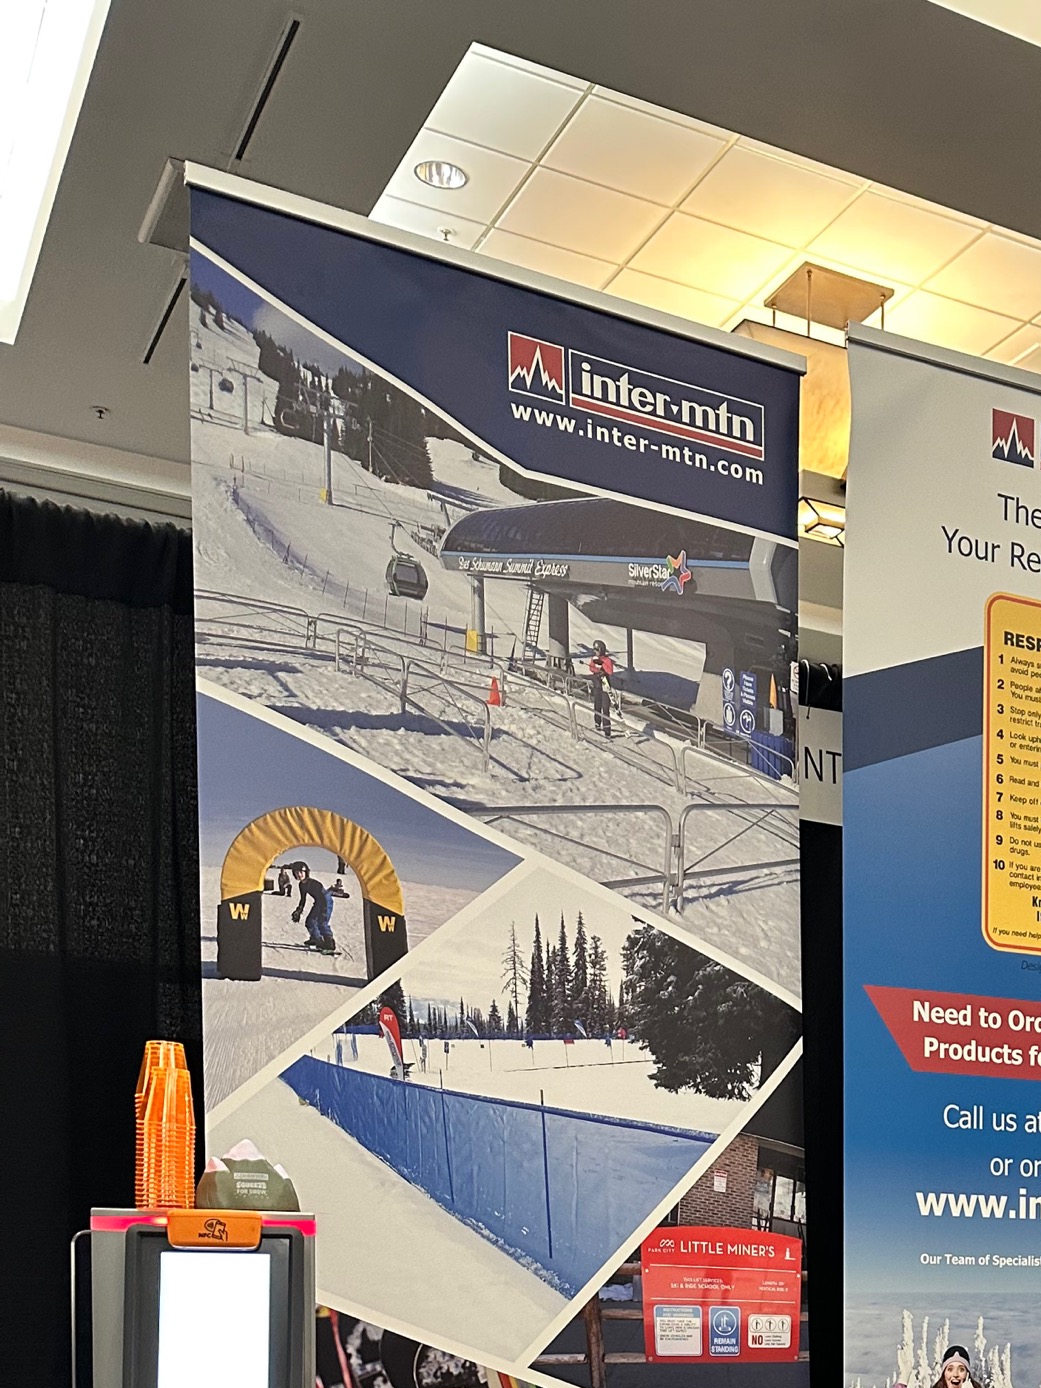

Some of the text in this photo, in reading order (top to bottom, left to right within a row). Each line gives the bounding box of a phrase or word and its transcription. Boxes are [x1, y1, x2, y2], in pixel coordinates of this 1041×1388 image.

[510, 402, 764, 485] www.inter-mtn.com
[942, 526, 1000, 564] Your
[504, 558, 532, 574] Summit
[535, 560, 569, 577] Express
[912, 1000, 972, 1027] Need
[979, 1007, 1001, 1028] to
[923, 1037, 1023, 1066] Products
[943, 1104, 984, 1131] Call
[992, 1110, 1017, 1132] us
[990, 1157, 1013, 1177] or
[680, 1241, 724, 1254] LITTLE
[727, 1244, 775, 1258] MINER'S
[920, 1253, 942, 1265] Our
[944, 1254, 976, 1266] Team
[979, 1254, 990, 1266] of
[752, 1335, 763, 1345] NO
